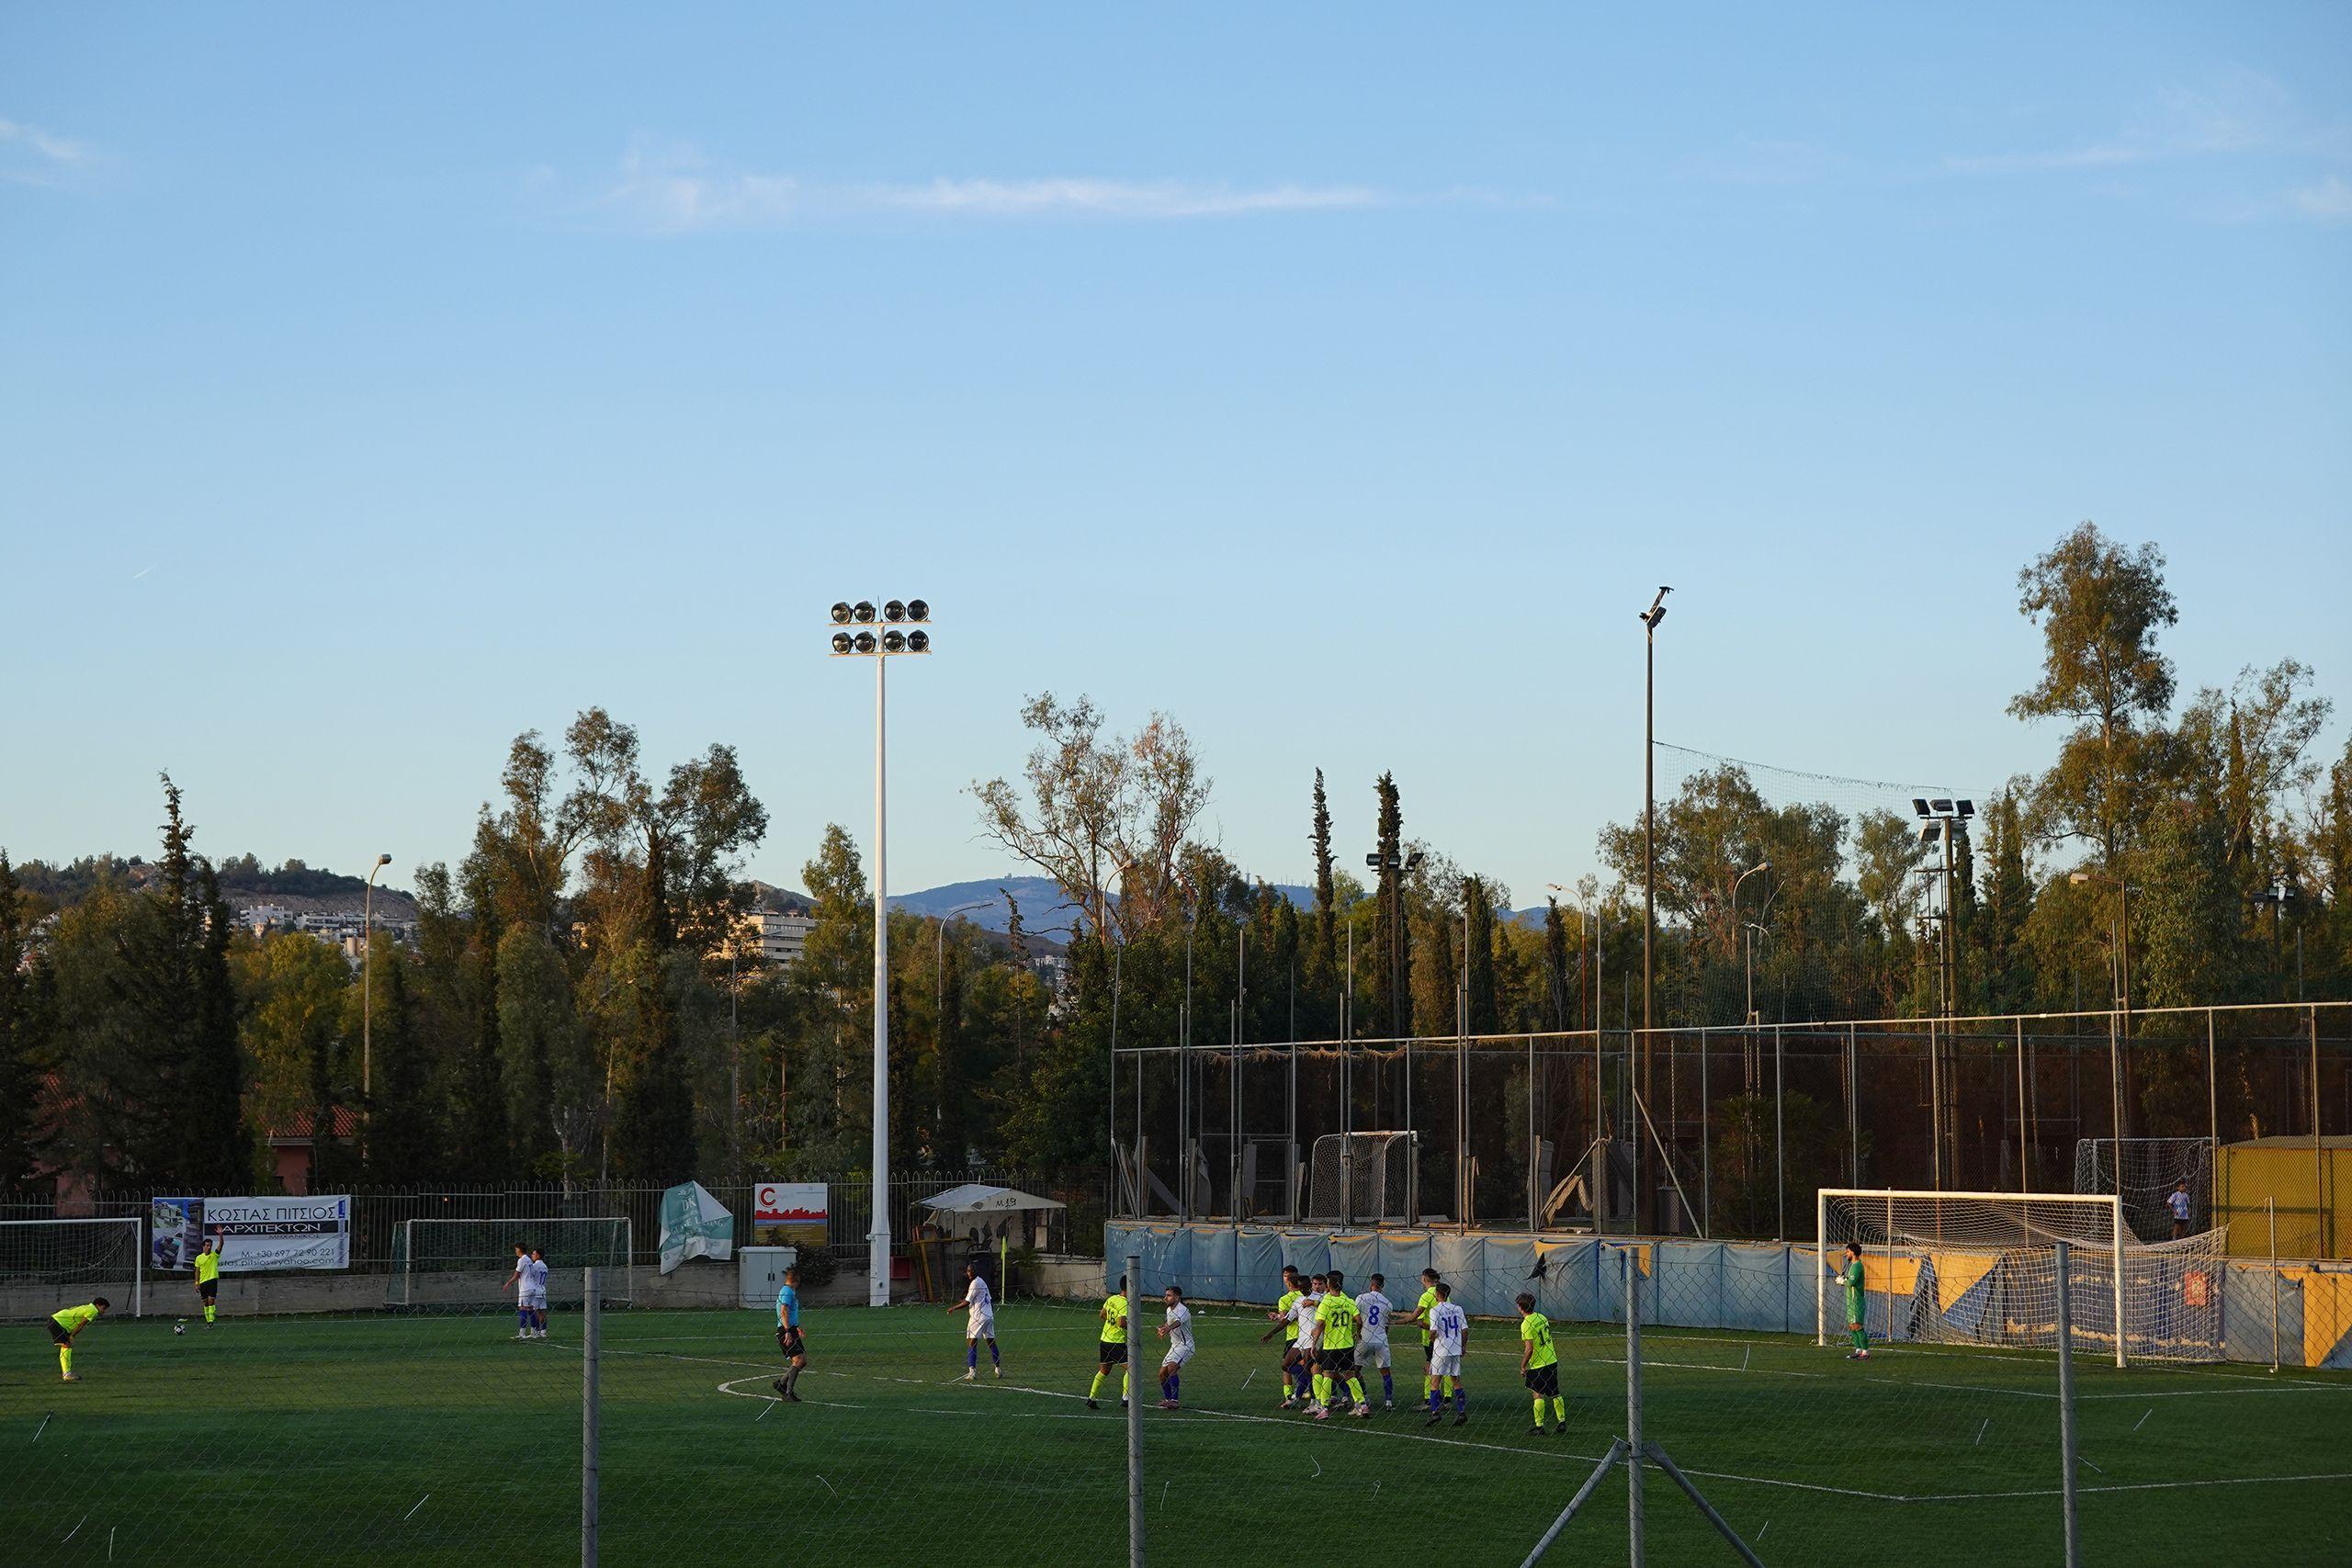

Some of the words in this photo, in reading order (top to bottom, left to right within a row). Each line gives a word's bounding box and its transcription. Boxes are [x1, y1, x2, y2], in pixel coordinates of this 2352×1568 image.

[208, 1208, 270, 1222] ΚΩΣΤΑΣ
[276, 1206, 335, 1220] ΠΙΤΣΙΟΣ
[222, 1223, 321, 1234] ΑΡΧΙΤΕΚΤΩΝ
[256, 1249, 273, 1258] +30
[275, 1249, 290, 1258] 697
[293, 1248, 305, 1258] 72
[307, 1248, 318, 1257] 90
[320, 1248, 334, 1257] 221
[1331, 1311, 1350, 1327] 20
[1368, 1304, 1380, 1325] 8
[1441, 1314, 1459, 1337] 14
